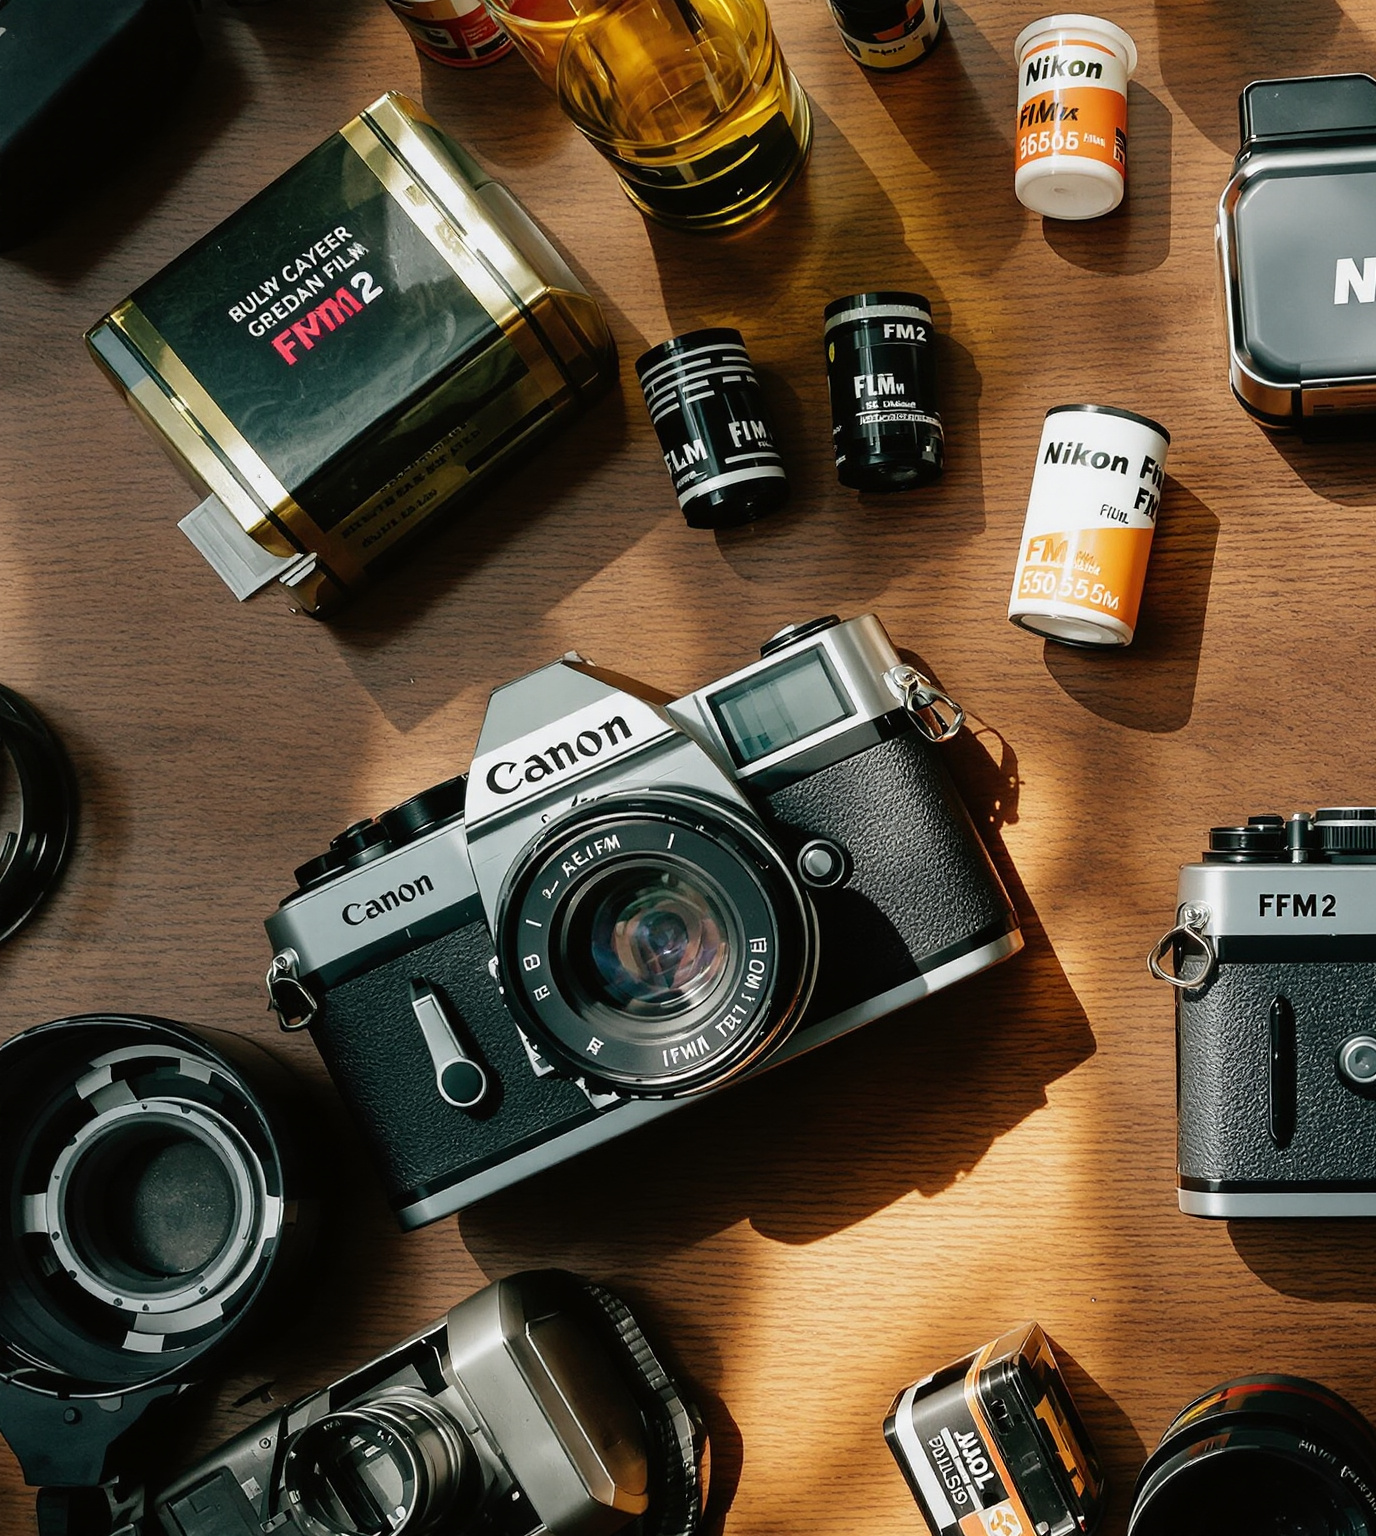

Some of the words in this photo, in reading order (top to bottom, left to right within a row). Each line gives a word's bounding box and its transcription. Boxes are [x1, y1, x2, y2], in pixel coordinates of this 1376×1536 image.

[1025, 54, 1103, 87] Nikon
[882, 323, 928, 342] FM2
[1043, 441, 1130, 476] Nikon
[486, 715, 633, 795] Canon
[342, 874, 435, 926] Canon
